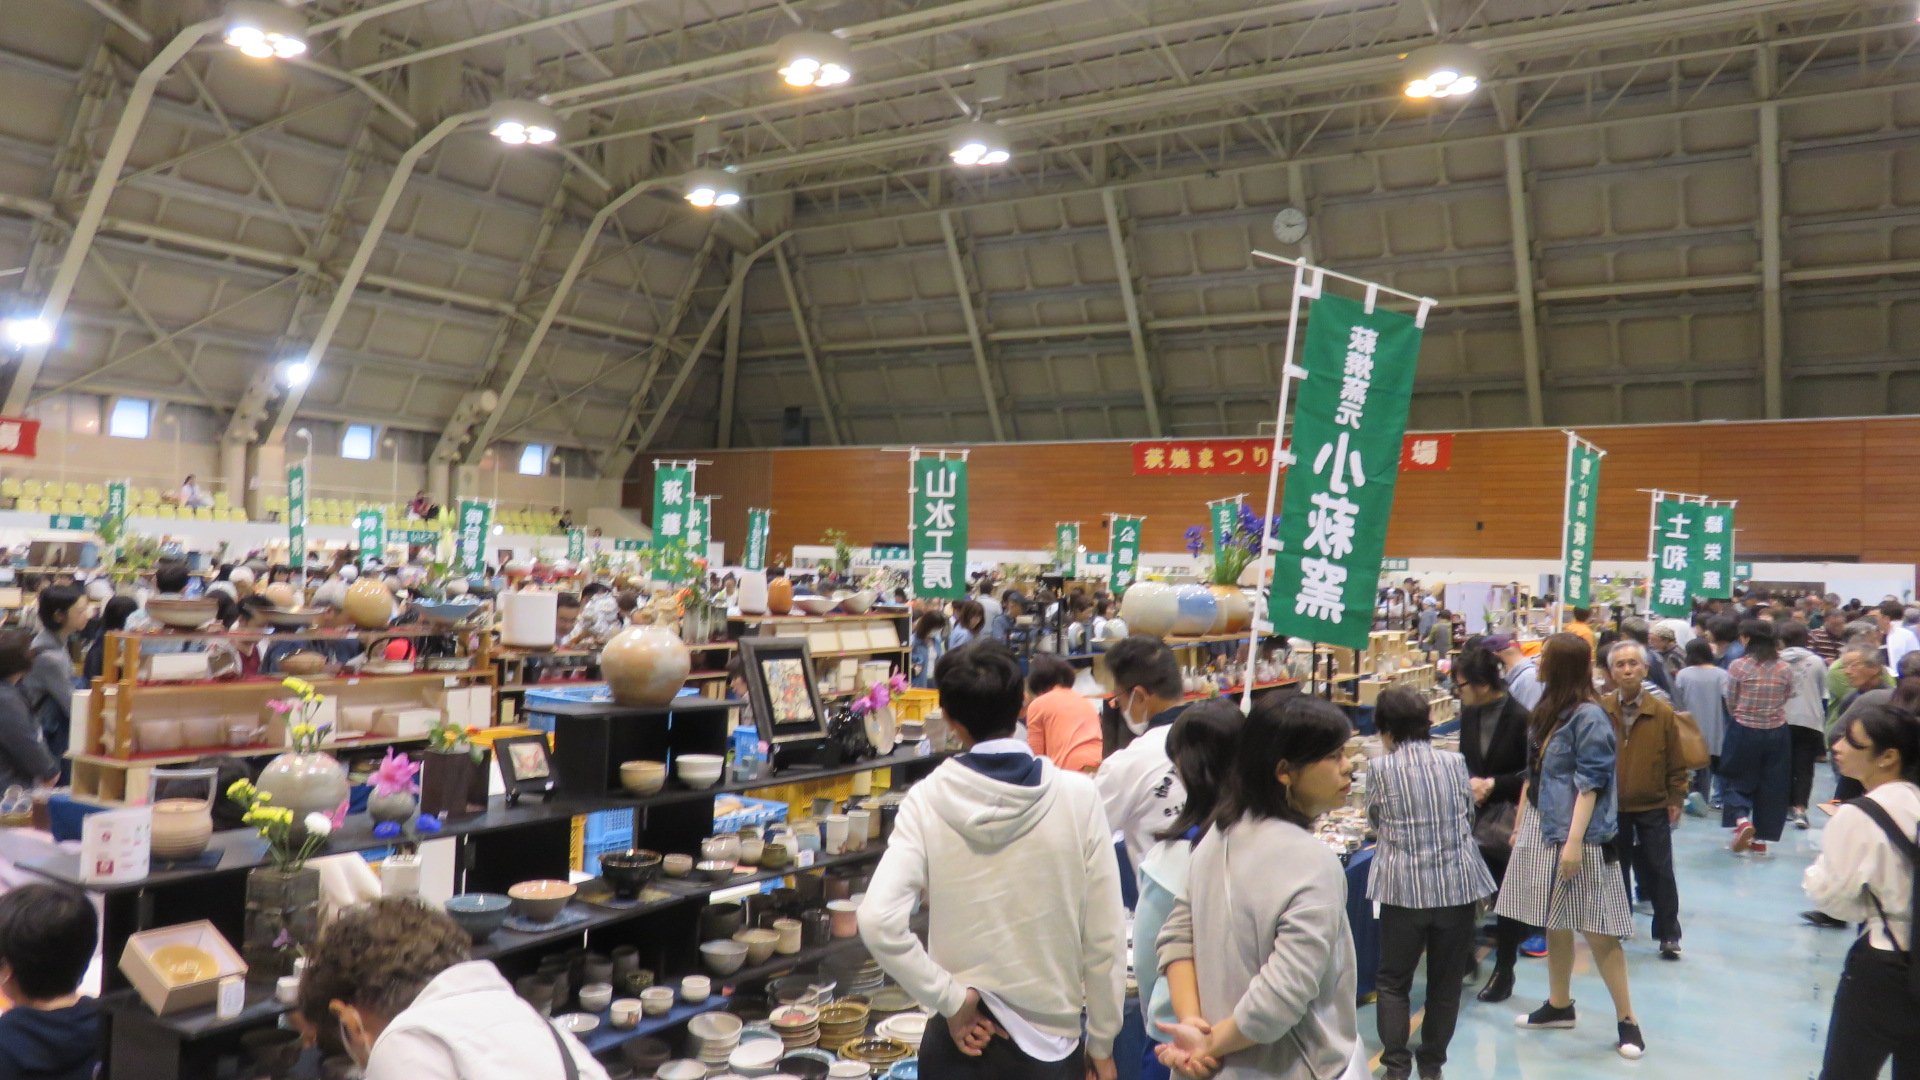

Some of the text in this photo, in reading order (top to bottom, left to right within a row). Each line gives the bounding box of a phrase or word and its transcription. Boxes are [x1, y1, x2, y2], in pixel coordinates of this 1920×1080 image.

[1143, 445, 1270, 469] 萩焼まつり
